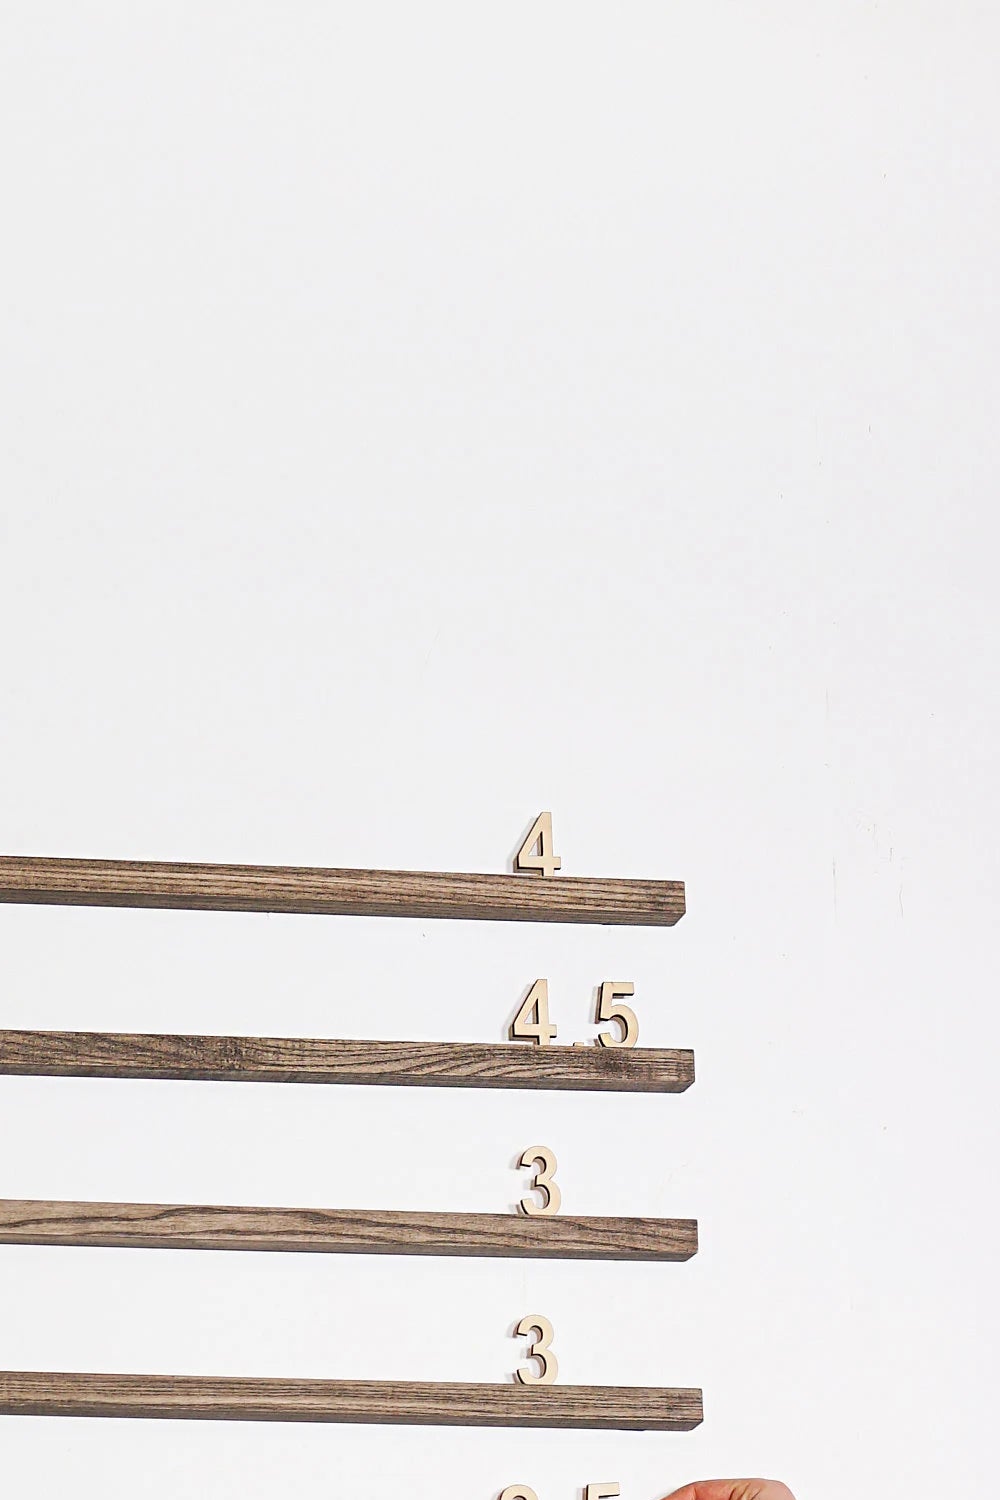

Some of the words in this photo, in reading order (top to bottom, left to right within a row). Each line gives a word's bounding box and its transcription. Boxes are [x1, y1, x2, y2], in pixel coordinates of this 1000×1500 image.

[515, 812, 561, 877] 4
[512, 979, 640, 1047] 4.5
[518, 1146, 561, 1216] 3
[516, 1314, 559, 1384] 3
